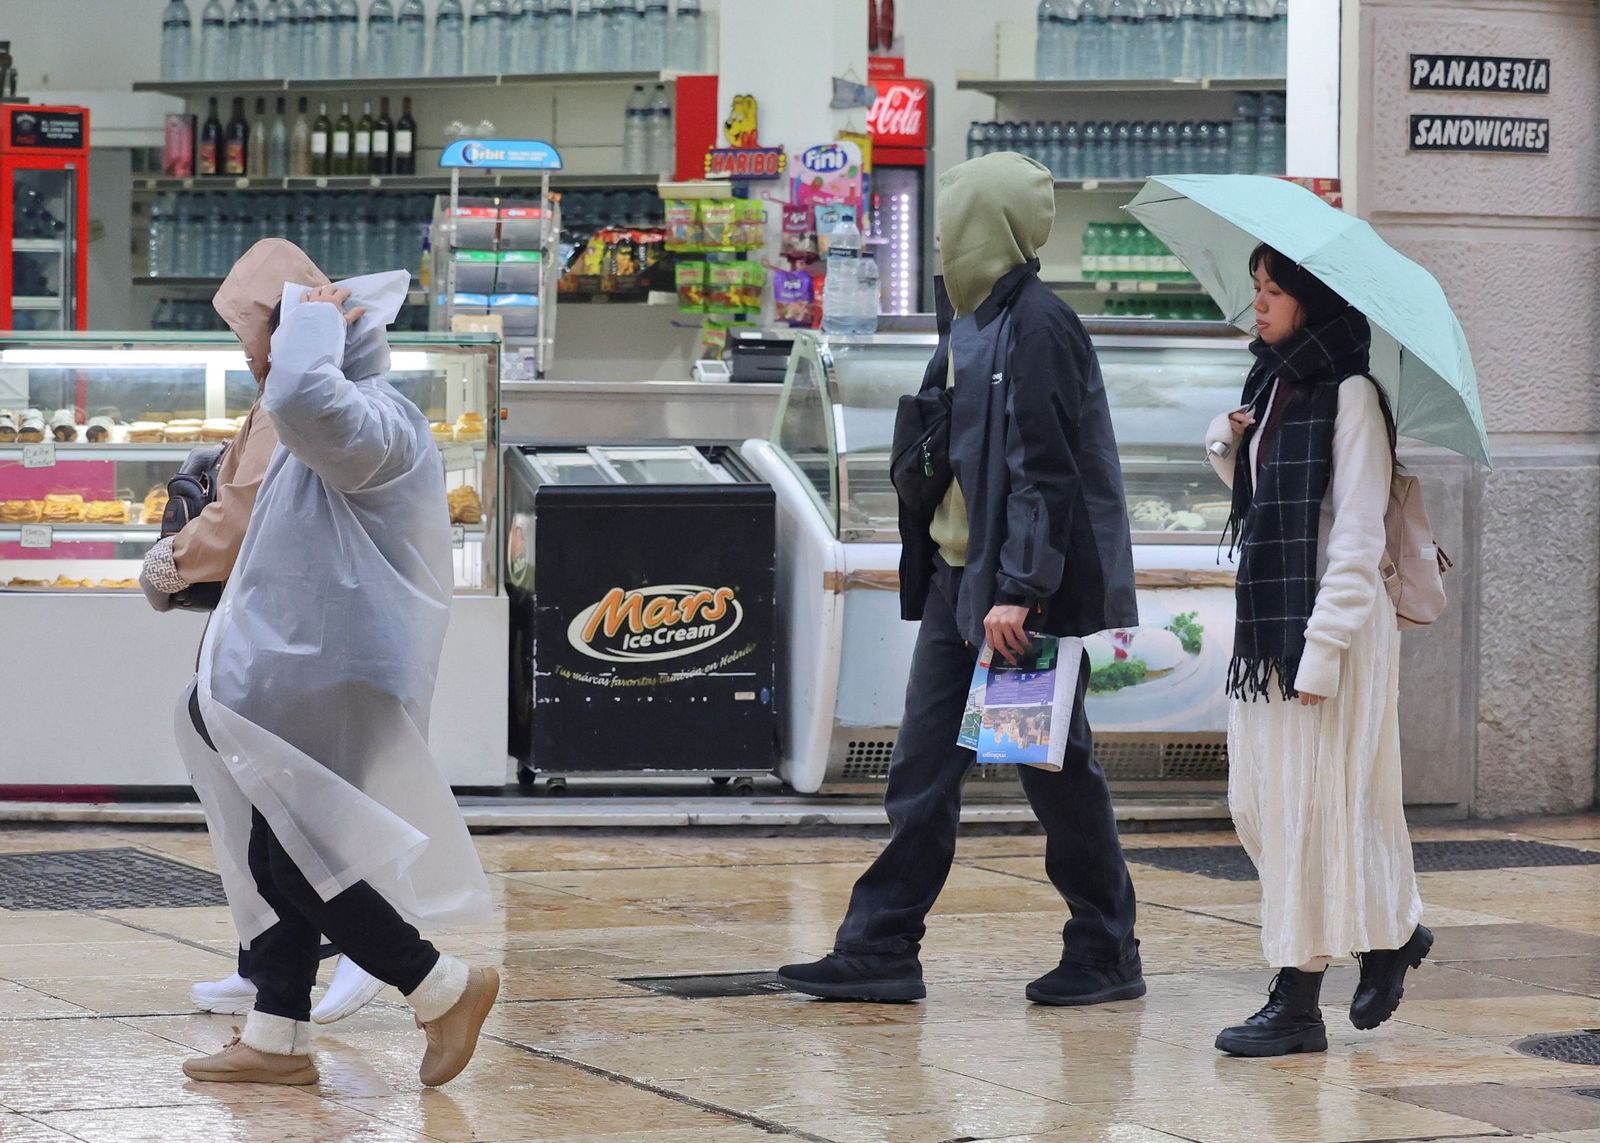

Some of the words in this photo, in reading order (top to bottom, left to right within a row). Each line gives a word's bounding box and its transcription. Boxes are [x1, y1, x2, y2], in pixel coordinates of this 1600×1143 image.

[1413, 59, 1547, 91] PANADERÍA
[1415, 119, 1548, 149] SANDWICHES
[712, 152, 778, 175] HARIBO
[805, 147, 843, 170] Fini
[582, 587, 734, 643] Mars
[623, 634, 651, 650] Ice
[653, 624, 716, 645] Cream
[704, 662, 718, 673] en
